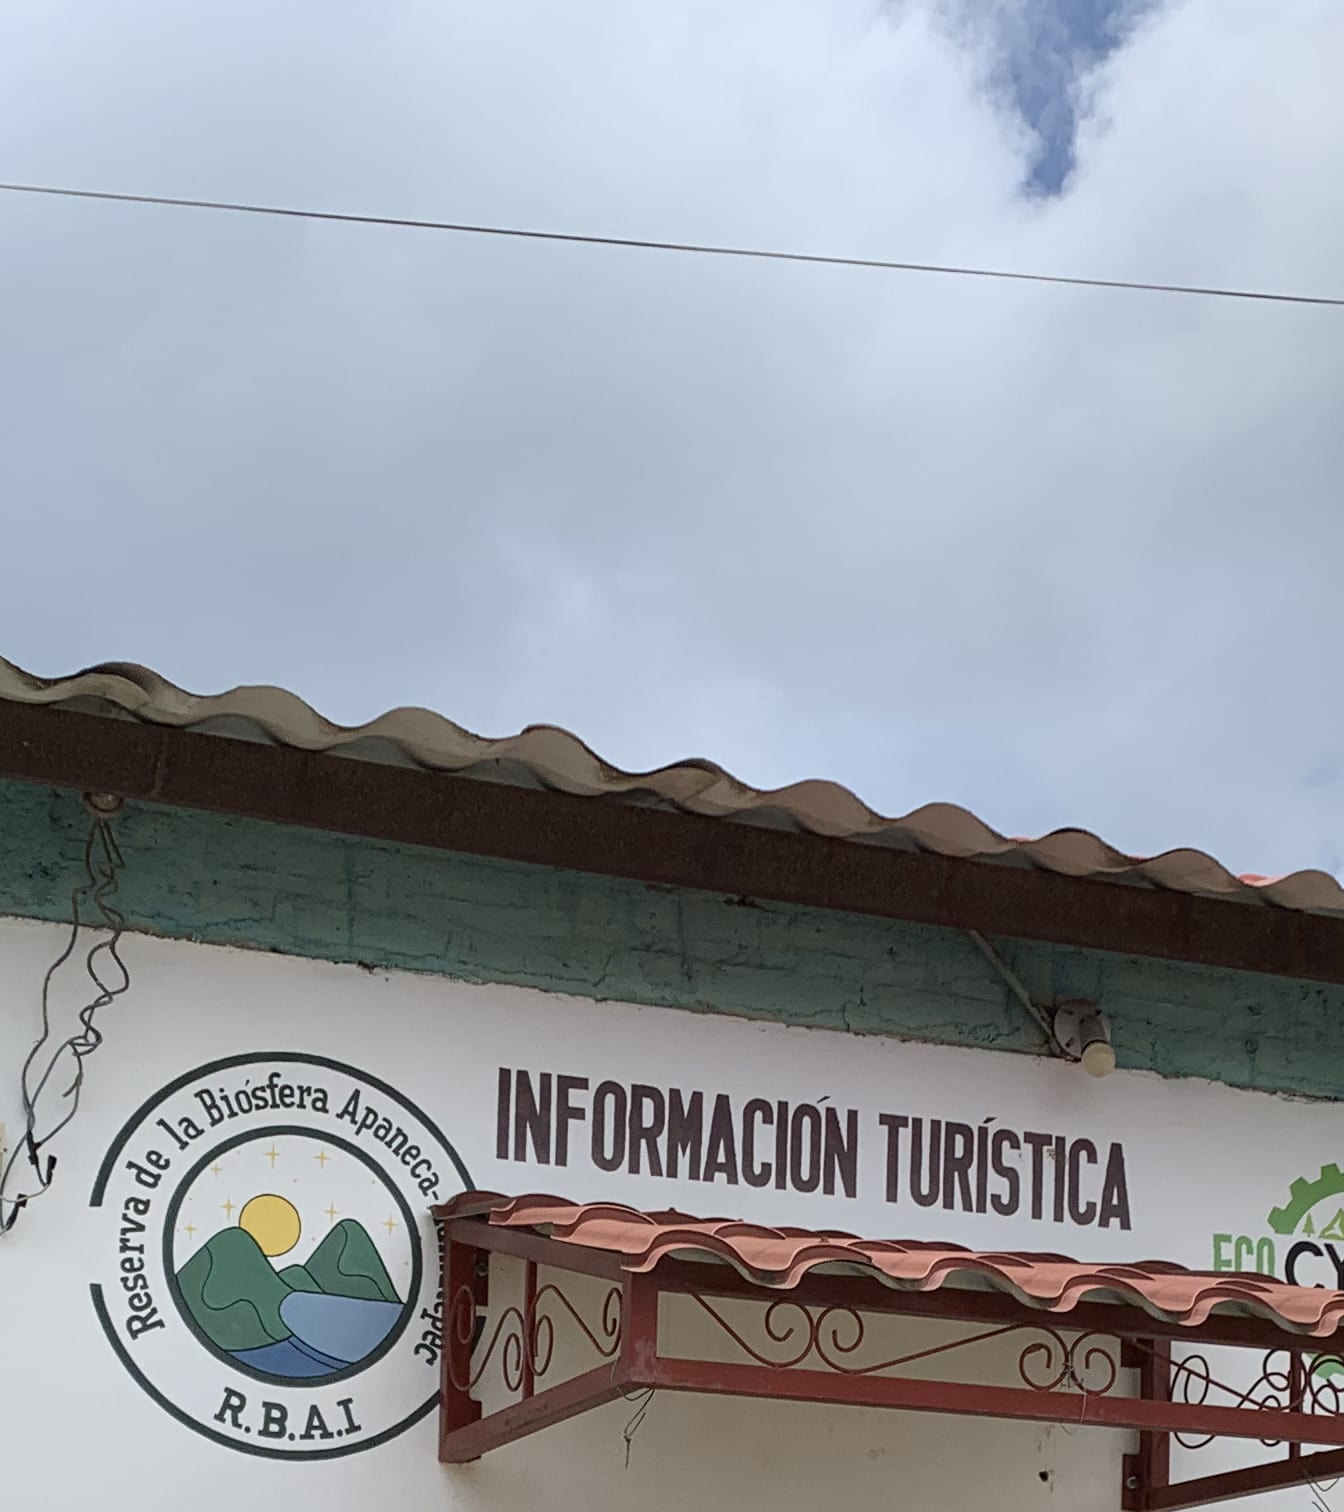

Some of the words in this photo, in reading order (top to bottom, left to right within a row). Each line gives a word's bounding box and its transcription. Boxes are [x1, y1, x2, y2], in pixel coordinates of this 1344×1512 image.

[194, 1073, 329, 1128] Biósfera
[156, 1114, 204, 1150] la
[495, 1067, 858, 1199] INFORMACIÓN
[879, 1113, 1131, 1231] TURÍSTICA
[126, 1149, 170, 1189] de
[119, 1199, 165, 1340] Reserva
[214, 1387, 362, 1440] R.B.A.I
